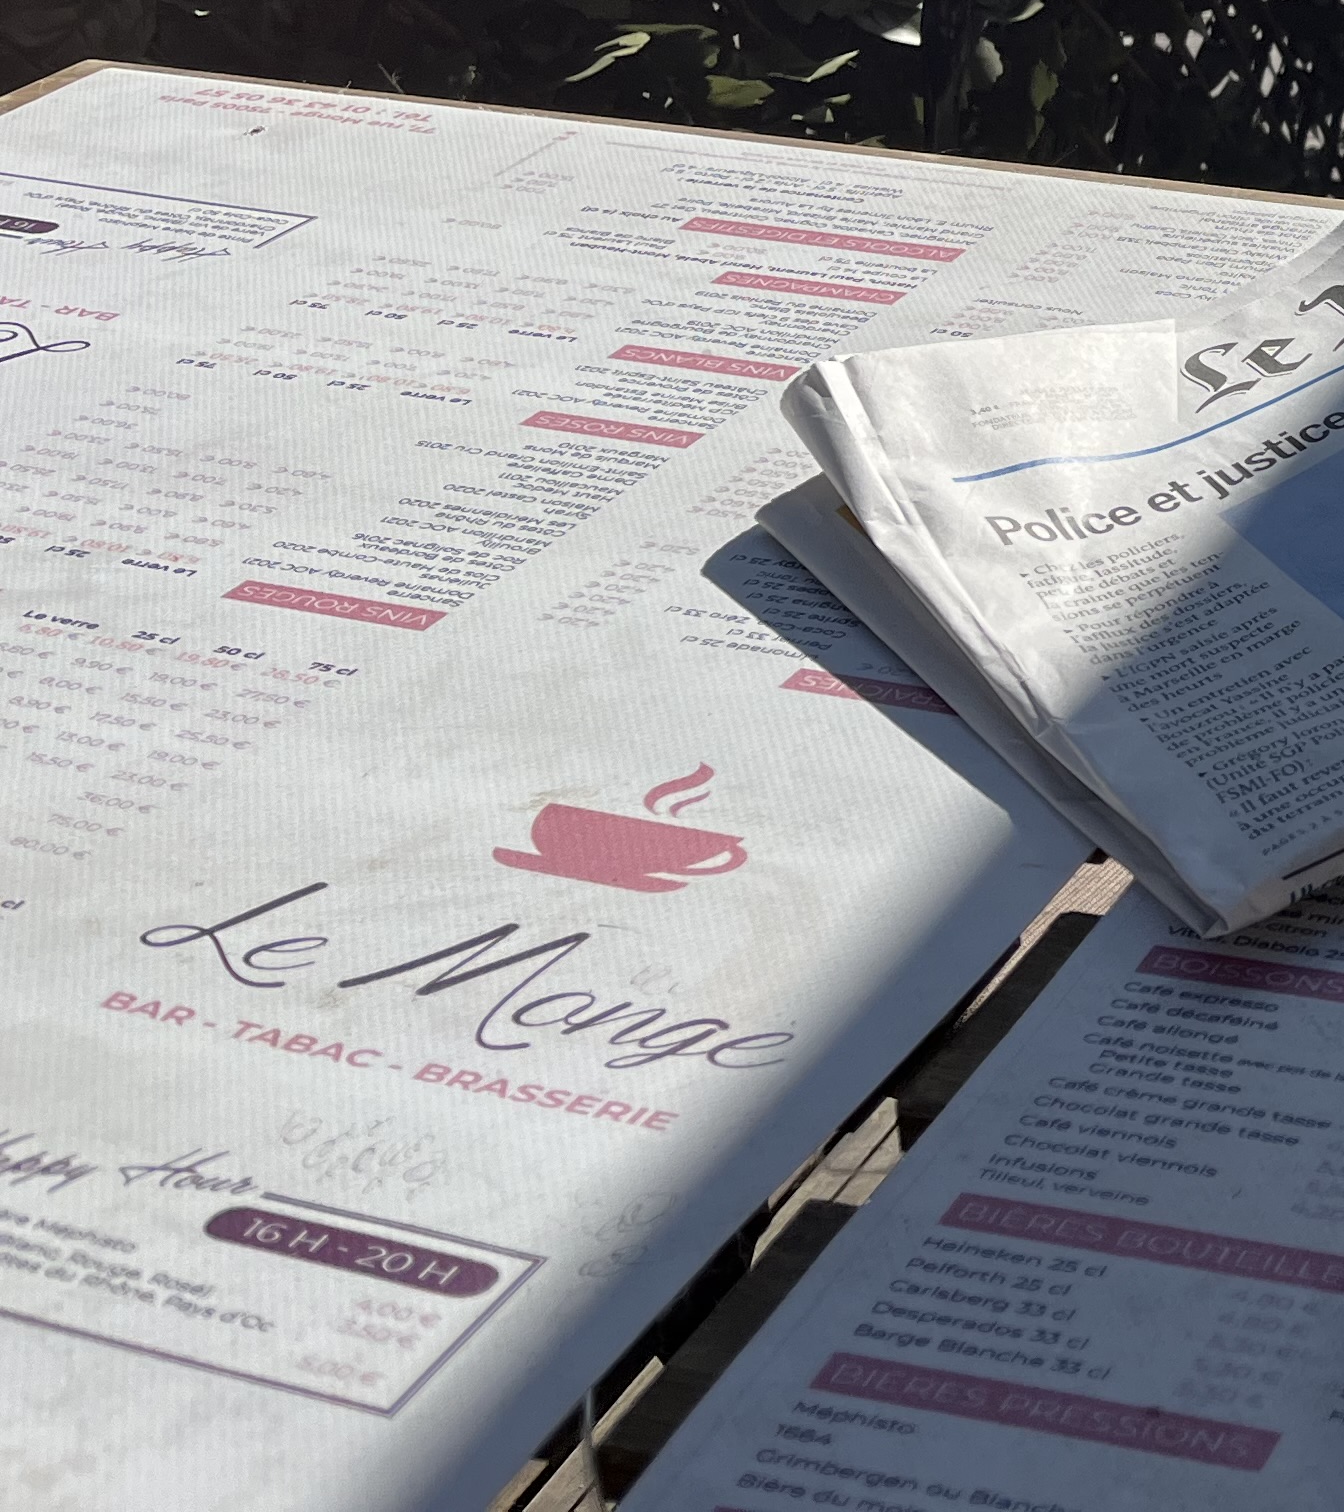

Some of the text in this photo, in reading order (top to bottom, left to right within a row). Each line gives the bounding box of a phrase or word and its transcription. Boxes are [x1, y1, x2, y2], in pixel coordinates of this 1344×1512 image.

[193, 88, 227, 99] 57
[303, 99, 335, 111] 43
[343, 102, 371, 114] 01
[289, 109, 362, 126] Monge
[366, 119, 396, 131] rue
[687, 218, 954, 260] ALCOOLS ET DIGESTIFS
[719, 273, 897, 303] CHAMPAGNES
[620, 347, 788, 379] VINS BLANCS
[1180, 334, 1309, 414] Le
[628, 430, 689, 447] VINS
[986, 498, 1142, 547] Police
[1147, 470, 1201, 516] et
[1199, 407, 1344, 498] justice
[542, 506, 593, 521] Syrah
[475, 537, 543, 556] Brouilly
[241, 556, 476, 600] Domaine Reverdy AOC 2021
[385, 588, 466, 608] Sancerre
[419, 572, 491, 590] Juliénas
[238, 584, 432, 628] VINS ROUGES
[1078, 579, 1220, 634] Pour répondre à
[23, 610, 358, 677] Le verre 25 cl 50 cl 75 cl
[1090, 617, 1219, 666] dans l'urgence
[1114, 606, 1278, 678] L'IGPN saisie après
[1117, 618, 1302, 704] à Marseille en marge
[1154, 645, 1313, 721] Un entretien avec
[1212, 737, 1289, 773] Grégory
[1240, 799, 1255, 814] Il
[1257, 781, 1299, 808] faut
[1249, 822, 1275, 840] du
[1278, 789, 1344, 826] terrain
[138, 880, 797, 1070] Le Monge
[1152, 951, 1344, 1001] BOISSONS
[1110, 998, 1161, 1016] Café
[1123, 979, 1279, 1014] Café expresso
[98, 990, 680, 1134] BAR TABAC BRASSERIE
[1082, 1031, 1234, 1065] Café noisette
[1099, 1049, 1234, 1079] Petite tasse
[1018, 1114, 1178, 1151] Café viennois
[118, 1148, 263, 1196] Hour
[988, 1153, 1100, 1182] Infusions
[242, 1216, 460, 1286] 16 H 20 H
[922, 1234, 1108, 1280] Heineken 25 cl
[906, 1256, 1073, 1297] Pelforth 25 cl
[852, 1321, 1114, 1382] Barge Blanche 33 cl
[791, 1398, 918, 1439] Méphisto
[1000, 1388, 1253, 1459] PRESSIONS
